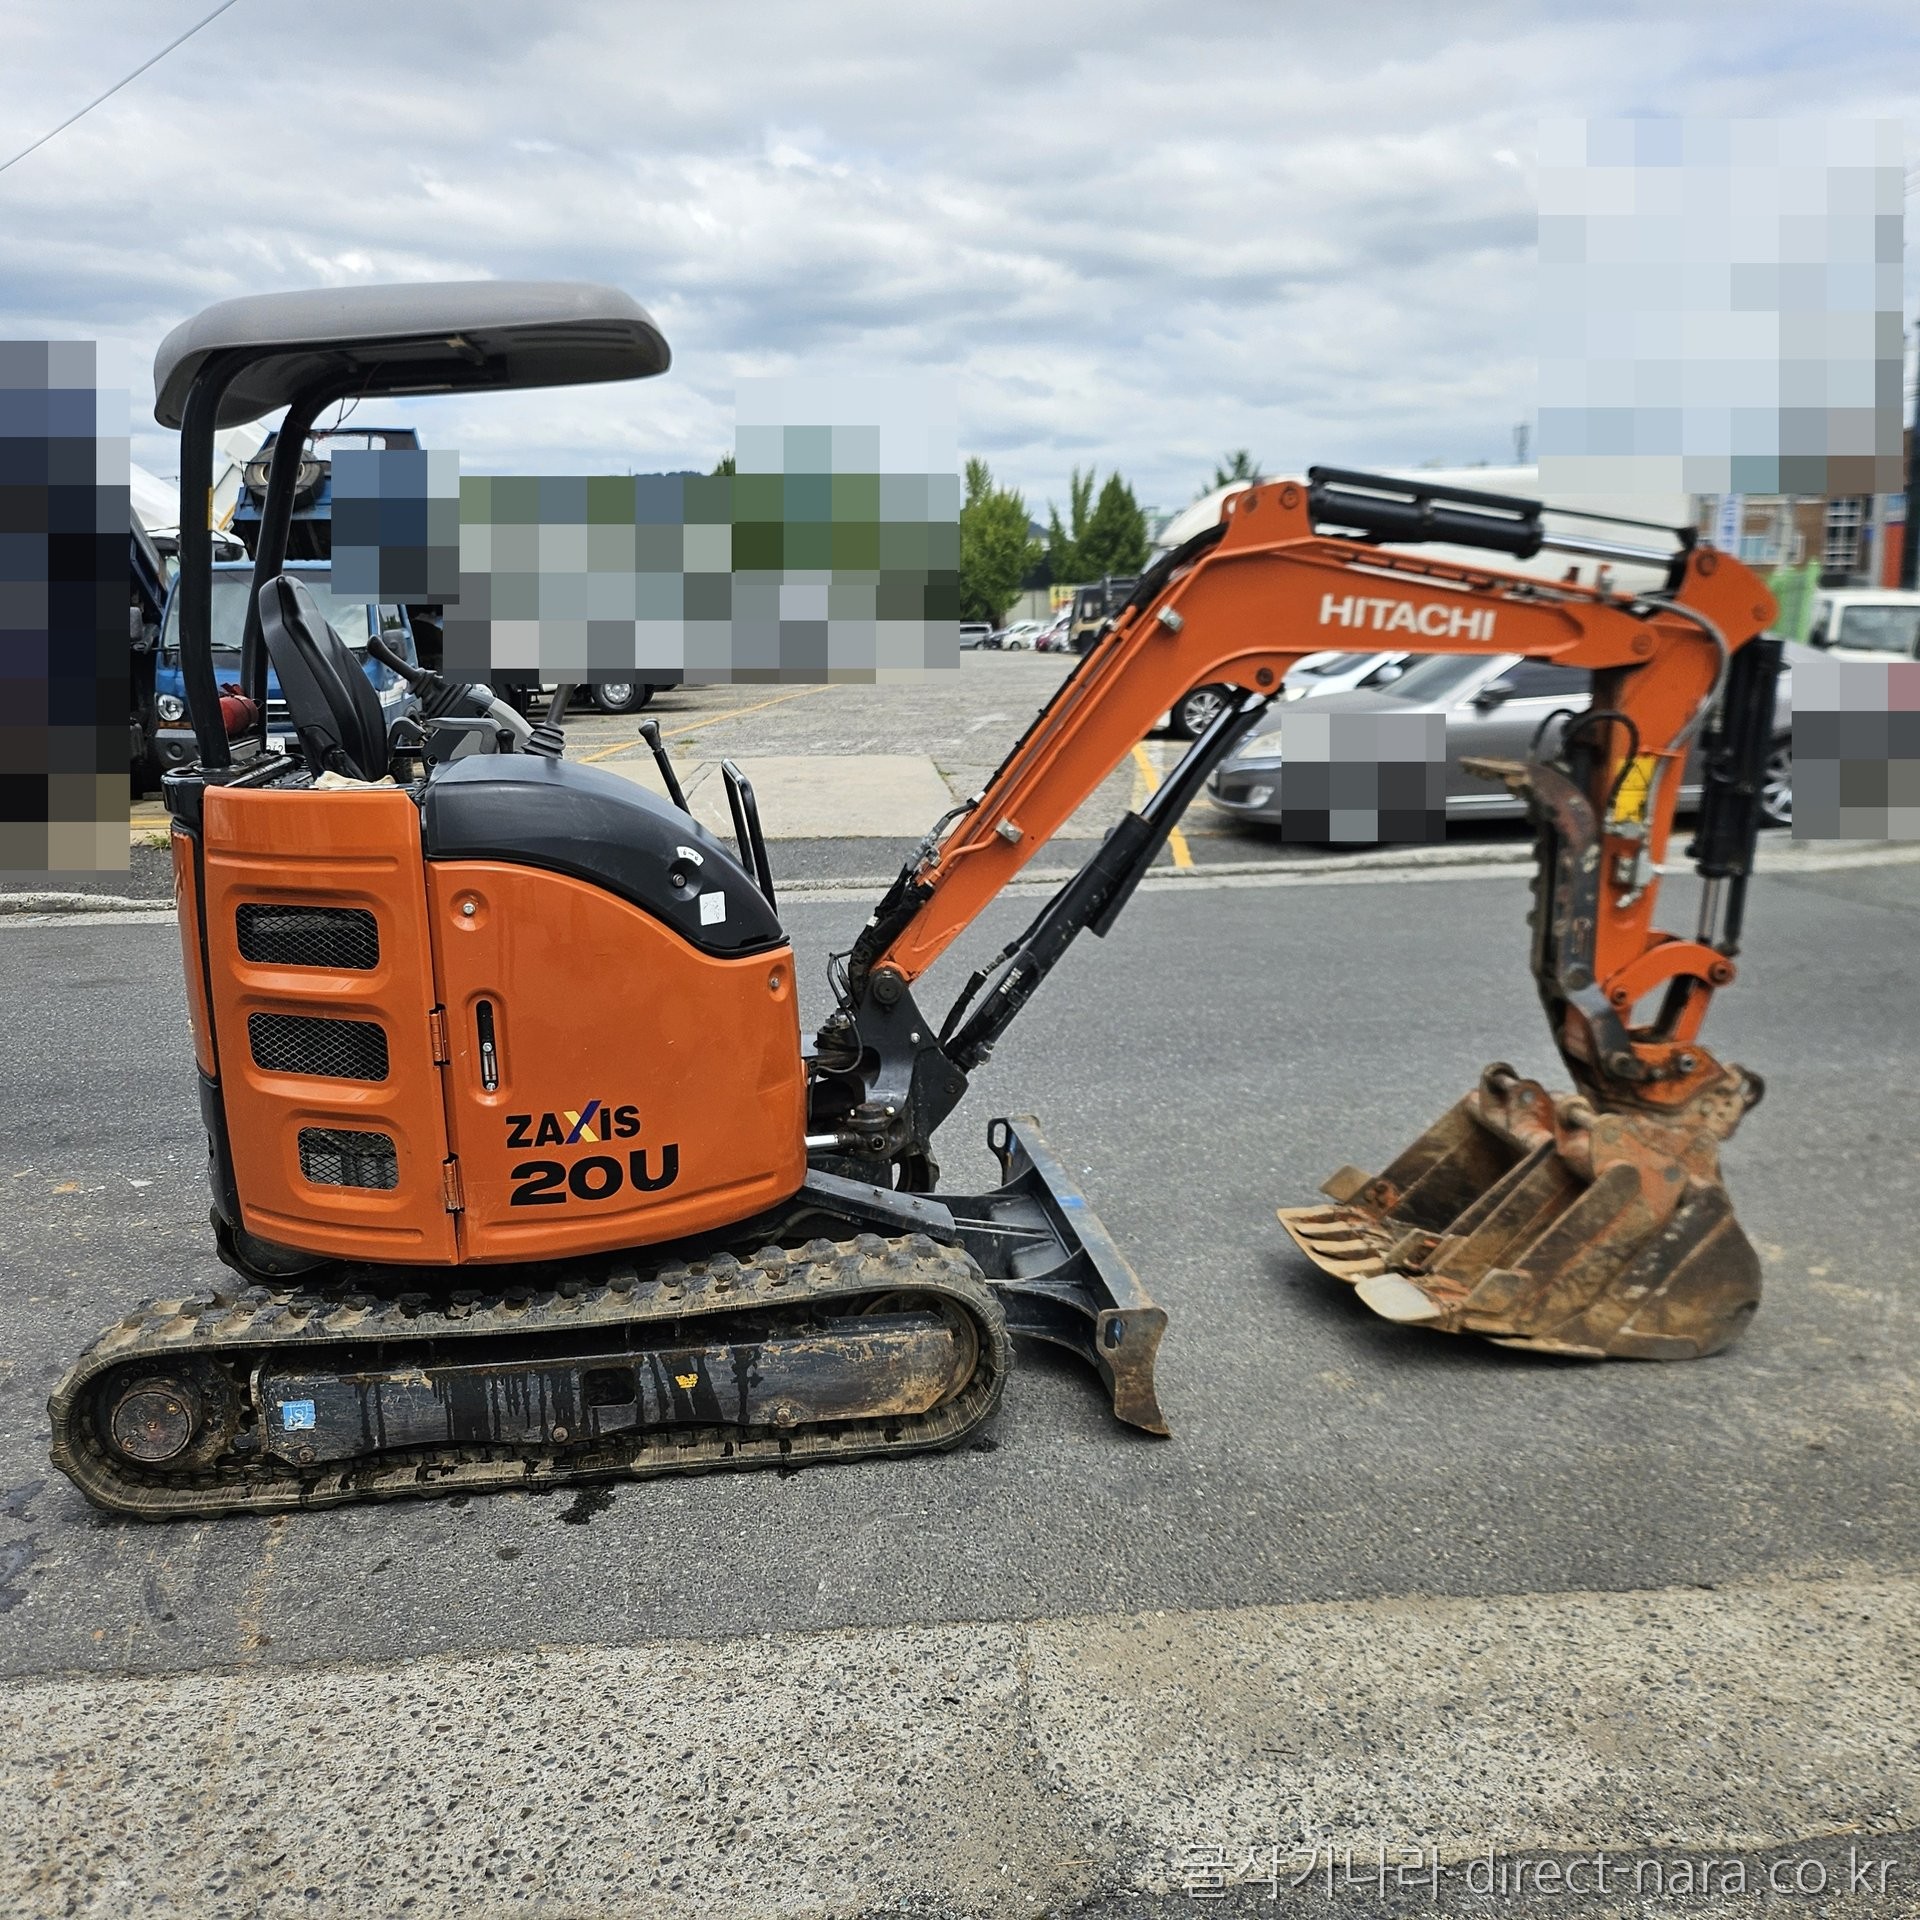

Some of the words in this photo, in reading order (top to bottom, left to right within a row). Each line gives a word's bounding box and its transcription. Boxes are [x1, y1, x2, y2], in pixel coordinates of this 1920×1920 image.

[1319, 594, 1496, 641] HITACHI
[506, 1100, 640, 1148] ZAXIS
[510, 1144, 678, 1206] 20U
